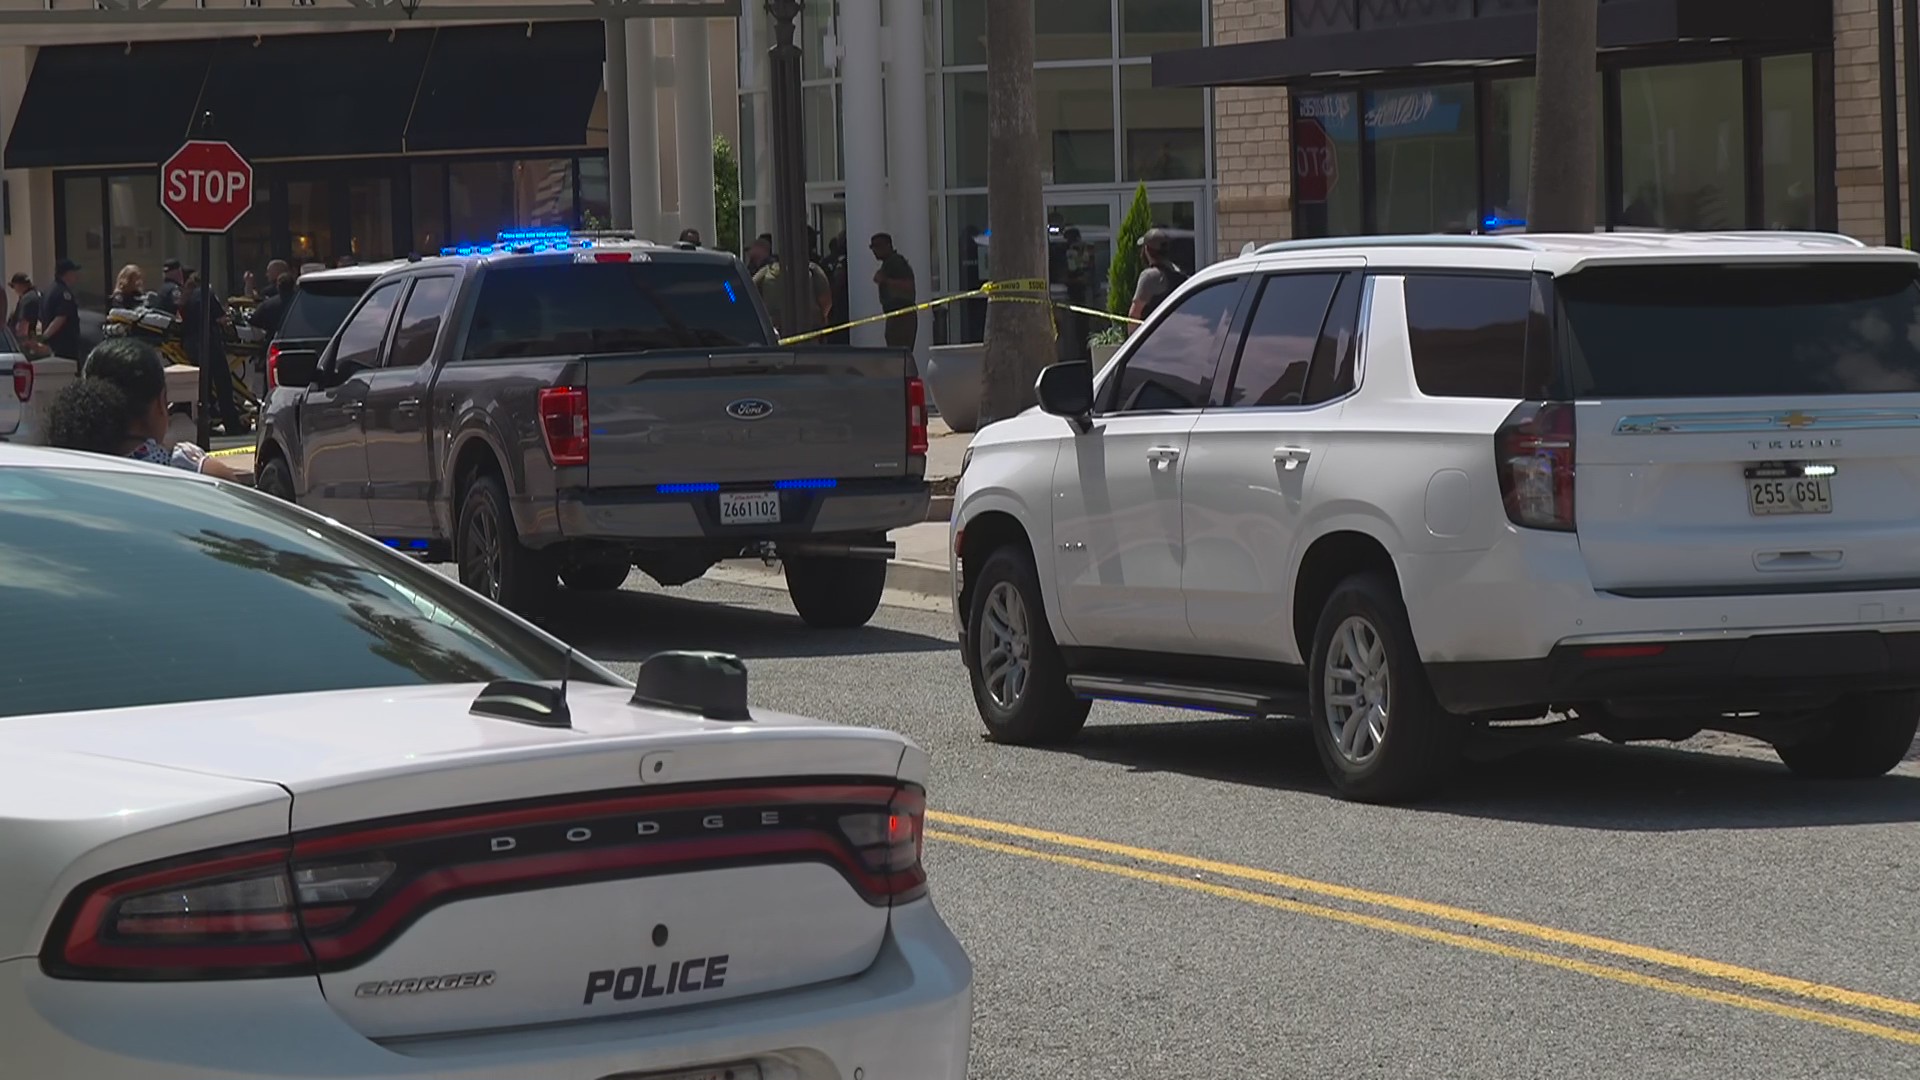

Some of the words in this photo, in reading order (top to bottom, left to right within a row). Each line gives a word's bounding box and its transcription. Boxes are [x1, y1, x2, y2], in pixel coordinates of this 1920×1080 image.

[168, 168, 246, 203] STOP
[738, 402, 763, 415] Ford
[1753, 482, 1785, 505] 255
[1796, 481, 1827, 502] GSL
[723, 501, 776, 518] Z661102
[490, 811, 779, 852] DODGE
[355, 971, 496, 998] CHARGER
[583, 955, 729, 1005] POLICE
